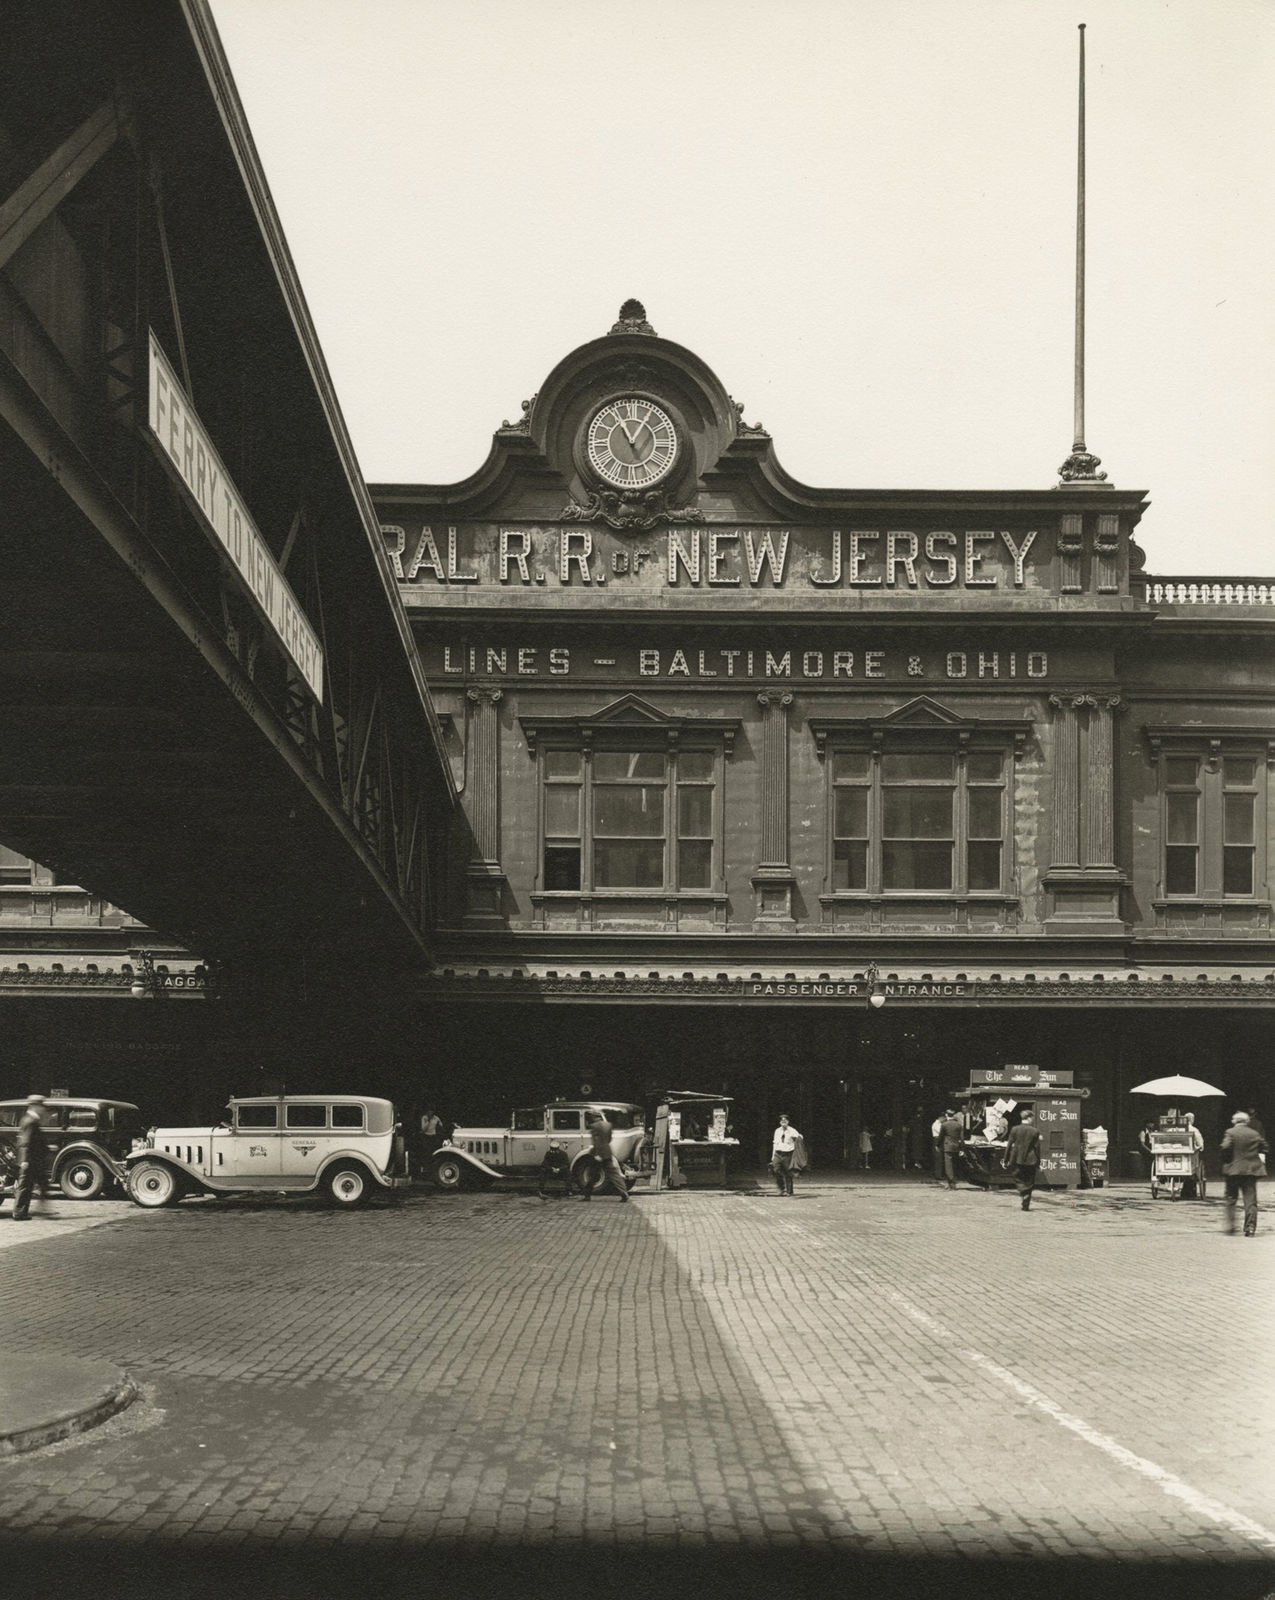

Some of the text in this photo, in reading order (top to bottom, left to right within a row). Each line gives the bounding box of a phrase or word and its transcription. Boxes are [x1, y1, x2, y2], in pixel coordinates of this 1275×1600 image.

[155, 365, 318, 690] FERRY TO NEW JERSEY
[611, 550, 650, 573] OF
[667, 529, 790, 584] NEW
[809, 530, 1038, 585] JERSEY
[444, 646, 570, 676] LINES
[639, 648, 886, 678] BALTIMORE
[907, 655, 925, 676] &
[946, 651, 1048, 678] OHIO
[752, 984, 966, 996] PASSENGER NTRANCE
[985, 1070, 1057, 1081] The Sun
[1039, 1109, 1078, 1121] The Sun
[1039, 1158, 1077, 1171] The Sun
[1091, 1167, 1105, 1178] The
